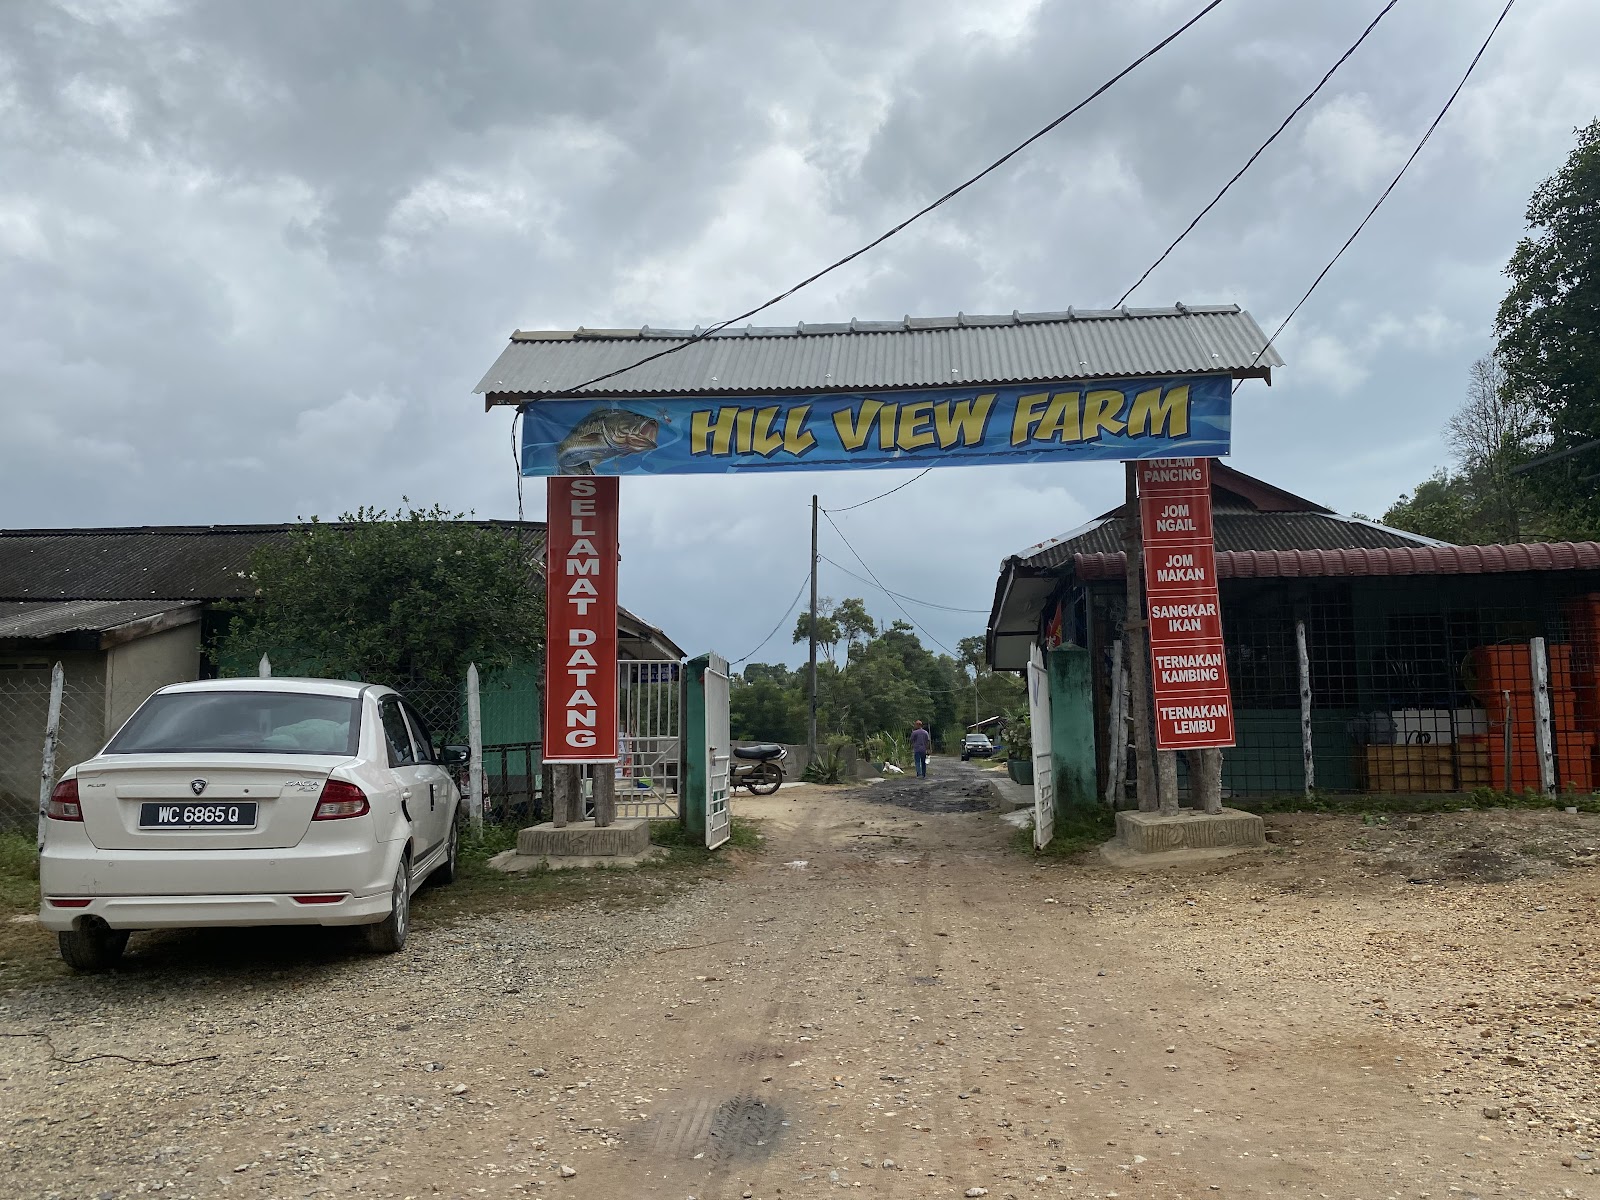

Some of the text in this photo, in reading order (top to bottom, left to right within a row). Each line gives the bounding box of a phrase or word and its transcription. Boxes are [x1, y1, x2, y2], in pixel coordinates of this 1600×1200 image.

[690, 384, 1193, 458] HILL VIEW FARM
[1143, 468, 1202, 482] PANCING
[1161, 504, 1190, 518] JOM
[1156, 518, 1197, 532] NGAIL
[1165, 554, 1194, 568] JOM
[1156, 567, 1205, 582] MAKAN
[565, 480, 600, 748] SELAMAT DATANG
[1151, 603, 1217, 618] SANGKAR
[1168, 618, 1202, 632] IKAN
[1155, 653, 1222, 669] TERNAKAN
[1161, 668, 1219, 683] KAMBING
[1160, 704, 1228, 720] TERNAKAN
[1173, 719, 1216, 734] LEMBU
[158, 806, 239, 823] WC 6865 Q
